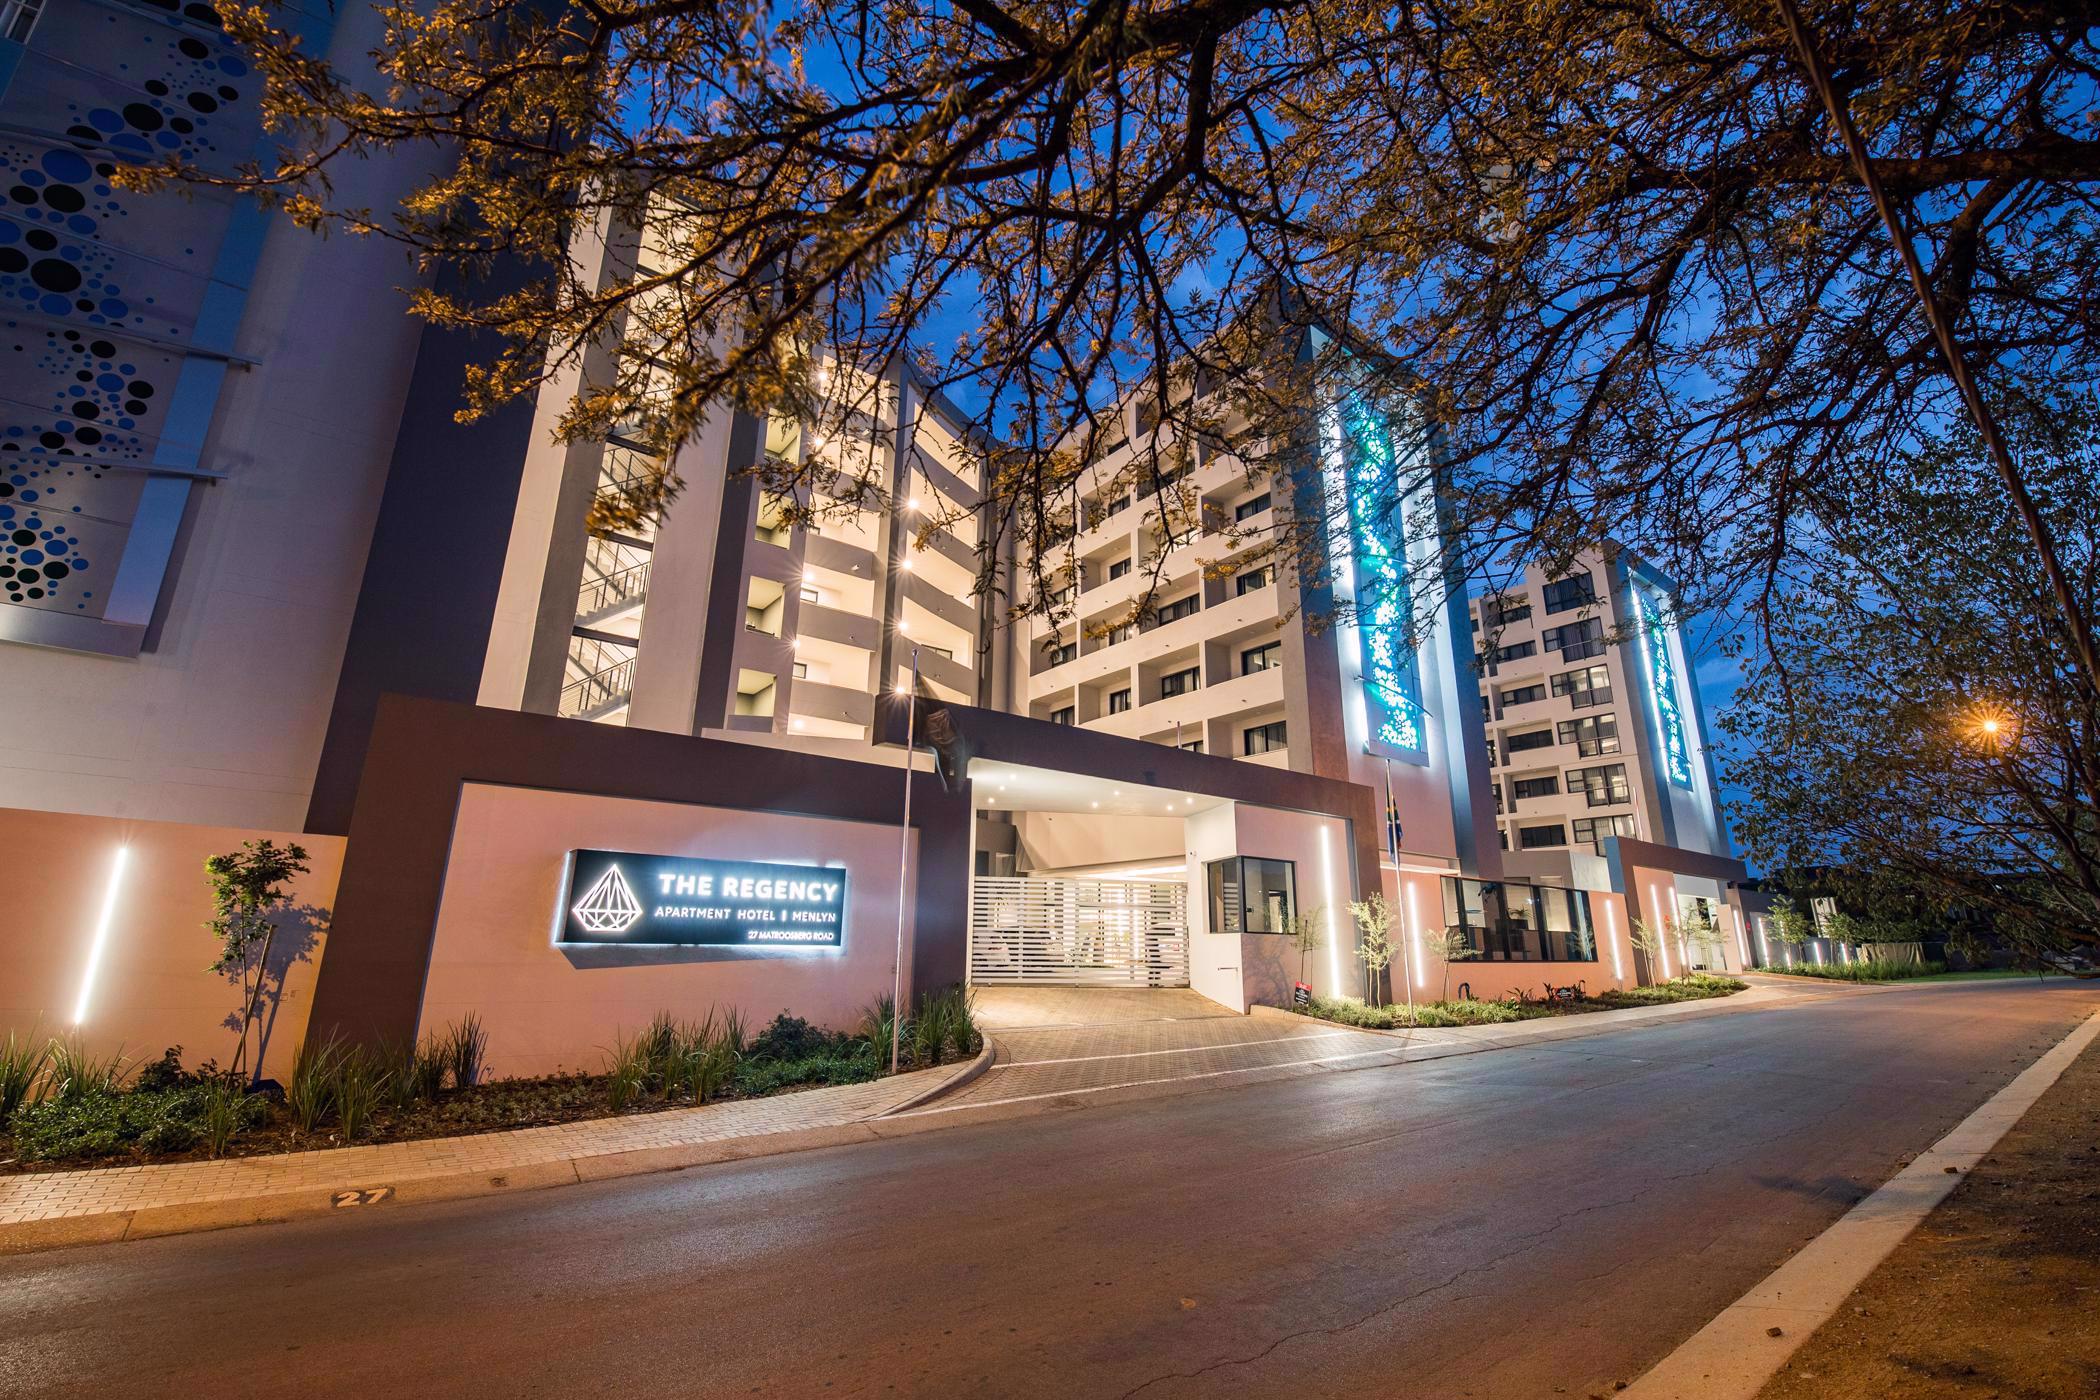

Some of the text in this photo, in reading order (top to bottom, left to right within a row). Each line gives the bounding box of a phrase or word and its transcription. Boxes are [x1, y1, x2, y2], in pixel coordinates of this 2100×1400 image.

[658, 873, 838, 900] THE REGENCY
[655, 906, 731, 919] APARTMENT
[738, 909, 776, 921] HOTEL
[792, 912, 836, 922] MENLYN
[748, 930, 757, 939] 27
[813, 932, 834, 940] ROAD
[337, 1188, 388, 1208] 27
